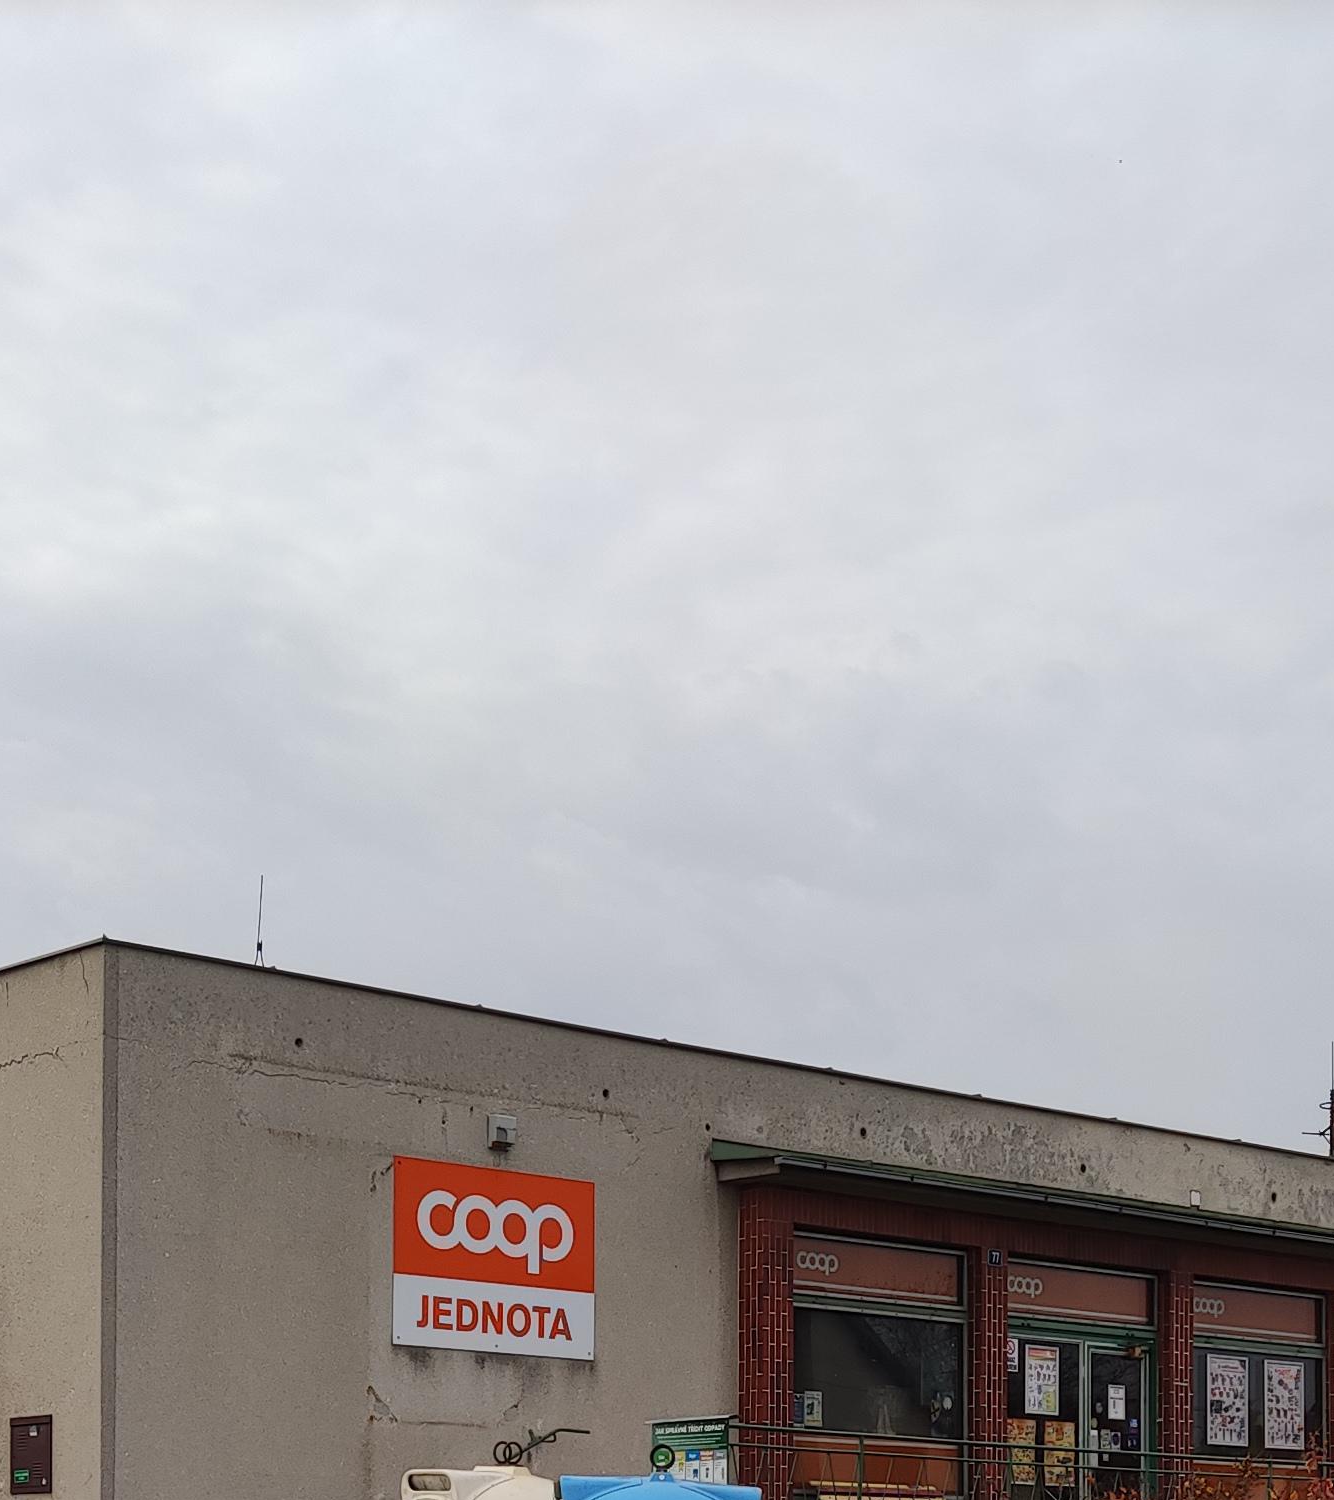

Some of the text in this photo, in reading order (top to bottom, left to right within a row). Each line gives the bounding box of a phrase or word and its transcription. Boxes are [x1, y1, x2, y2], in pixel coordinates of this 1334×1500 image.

[417, 1189, 576, 1275] coop
[796, 1250, 839, 1276] coop
[1007, 1275, 1043, 1299] coop
[417, 1294, 573, 1341] JEDNOTA
